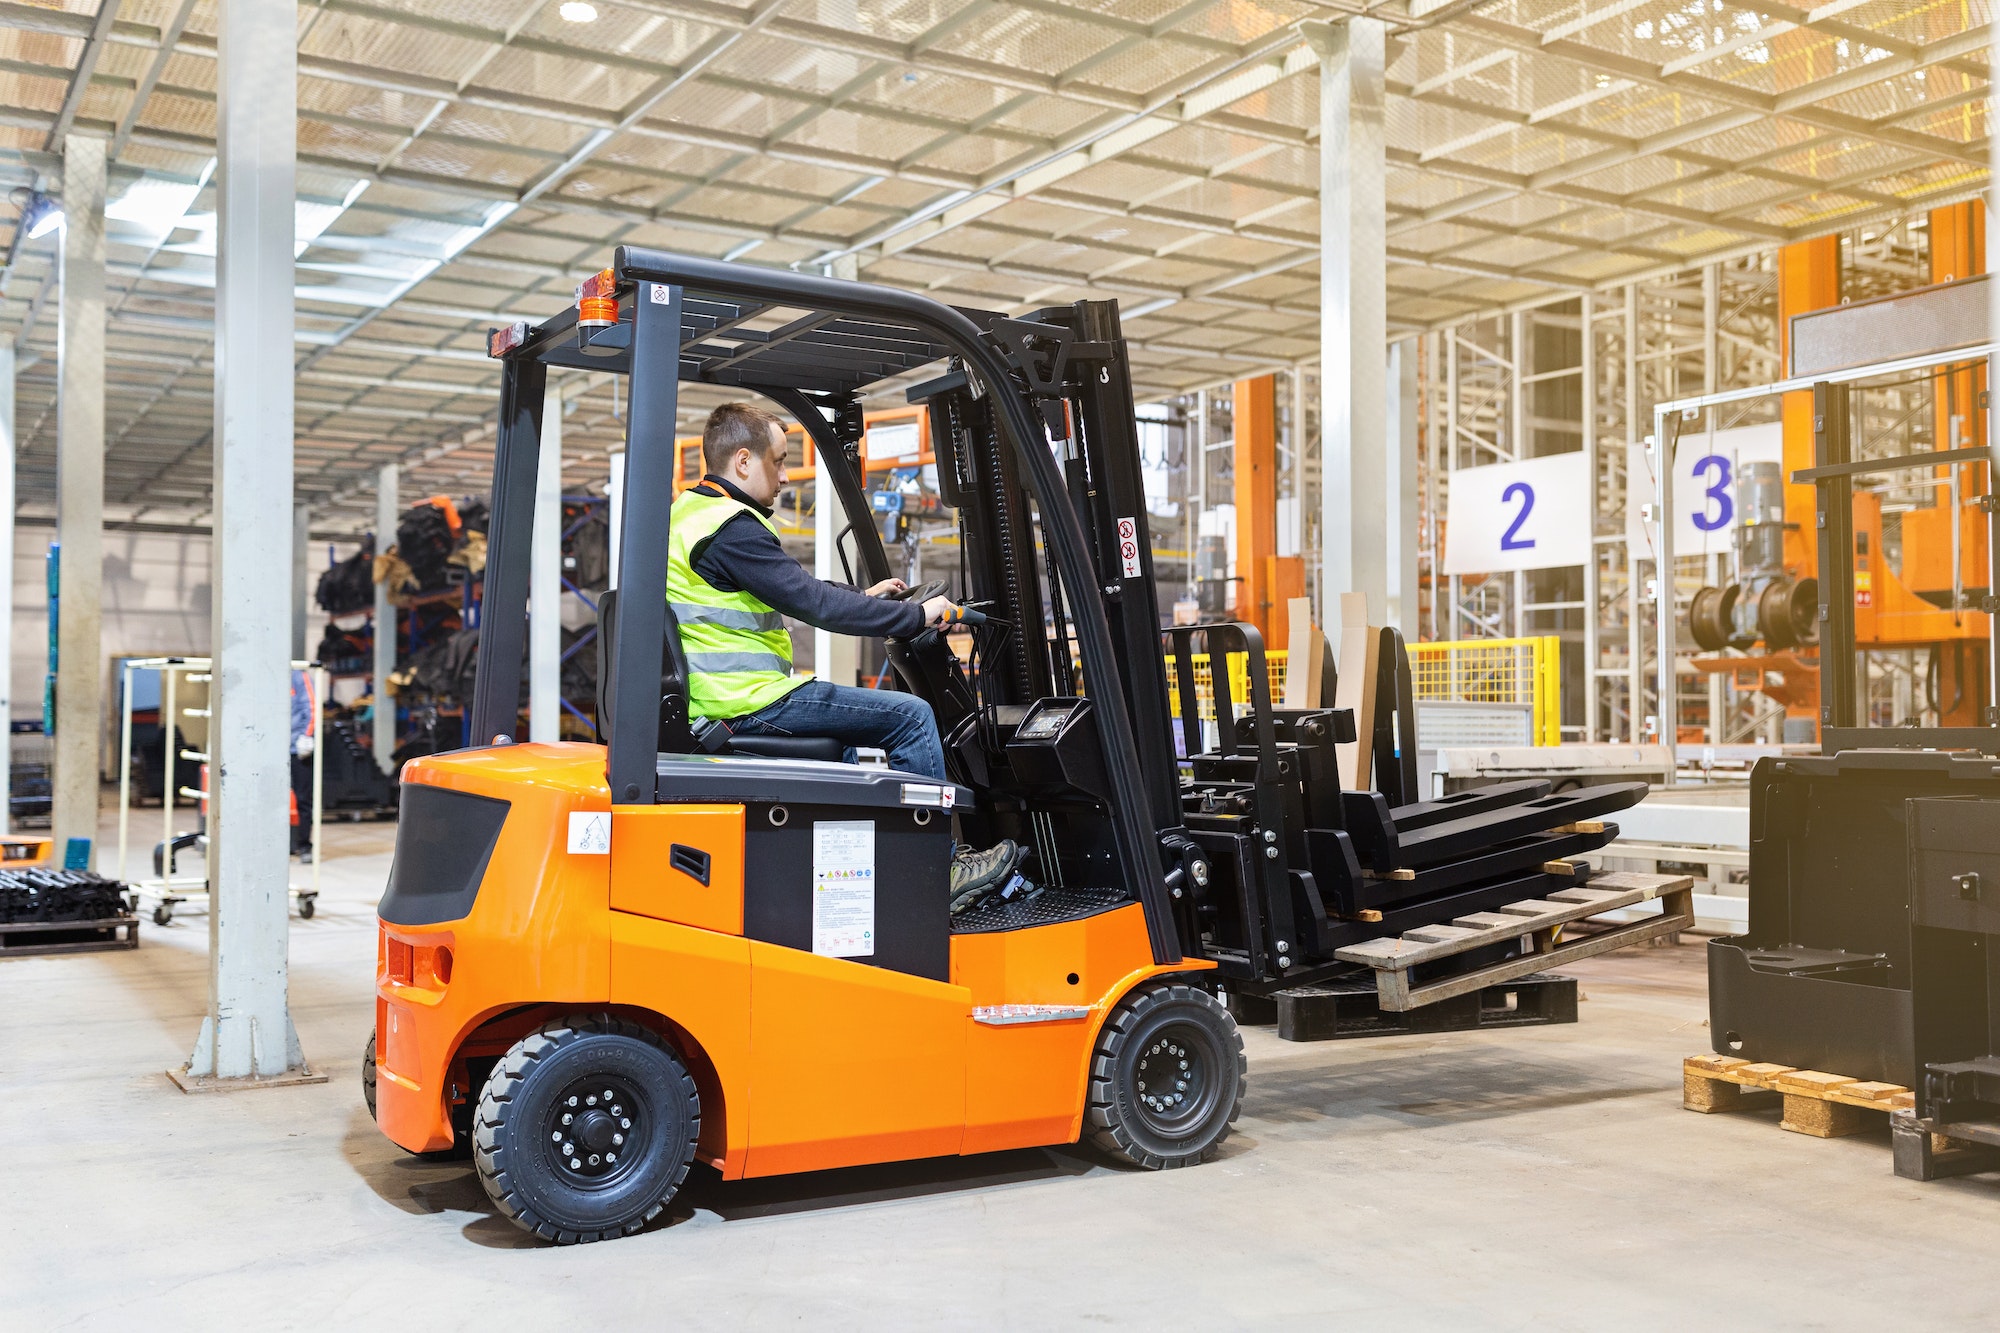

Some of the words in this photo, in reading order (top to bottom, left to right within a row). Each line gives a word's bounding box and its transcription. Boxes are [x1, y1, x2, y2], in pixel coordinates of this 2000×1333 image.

[1500, 482, 1535, 551] 2
[1692, 455, 1733, 531] 3
[572, 1049, 624, 1066] 5.00-8
